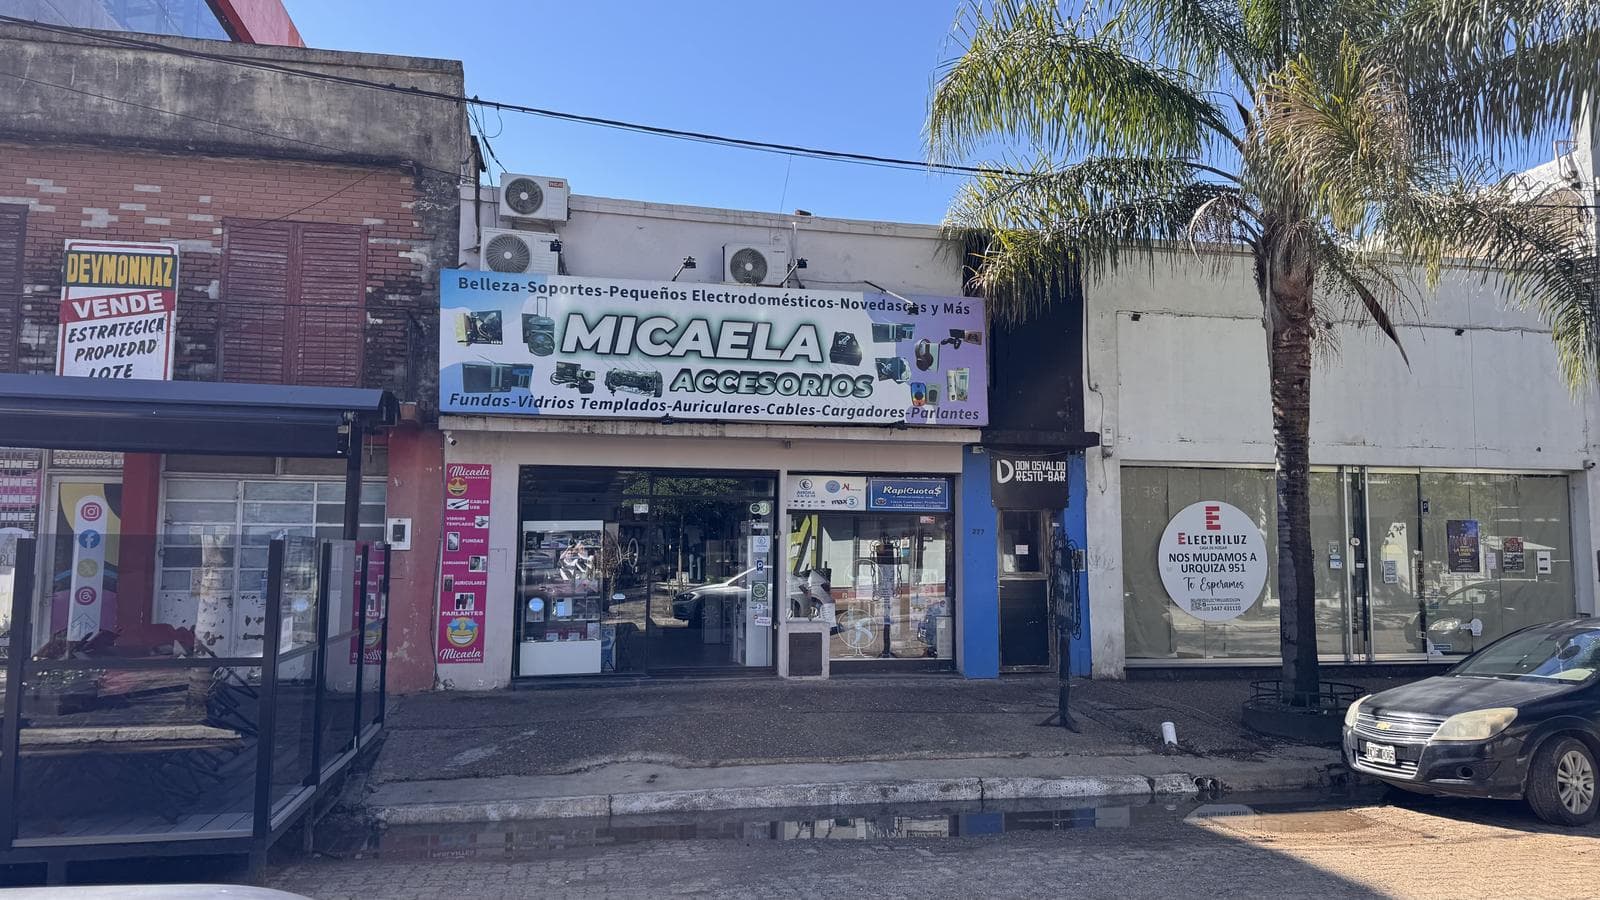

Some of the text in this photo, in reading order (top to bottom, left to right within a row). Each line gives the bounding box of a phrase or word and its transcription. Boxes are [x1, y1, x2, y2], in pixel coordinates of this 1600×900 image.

[67, 254, 173, 287] DEYMONNAZ
[72, 292, 164, 319] VENDE
[458, 276, 687, 301] Belleza-Soportes-Pequeños
[931, 304, 939, 316] y
[943, 301, 970, 315] Más
[68, 317, 166, 343] ESTRATEGICA
[560, 311, 824, 363] MICAELA
[74, 339, 157, 362] PROPIEDAD
[669, 367, 874, 398] ACCESORIOS
[449, 392, 980, 420] Fundas-Vidrios Templados-Auriculares-Cables-Cargadores-Parlantes
[449, 465, 490, 477] Micaela
[1015, 460, 1066, 471] DON OSVALDO
[1016, 471, 1066, 482] RESTO-BAR
[1177, 532, 1247, 545] ELECTRILUZ
[1168, 552, 1257, 562] NOS MUDAMOS A
[1181, 563, 1246, 574] URQUIZA 951
[1183, 576, 1245, 596] Te Esperamos
[439, 648, 481, 660] Micaela
